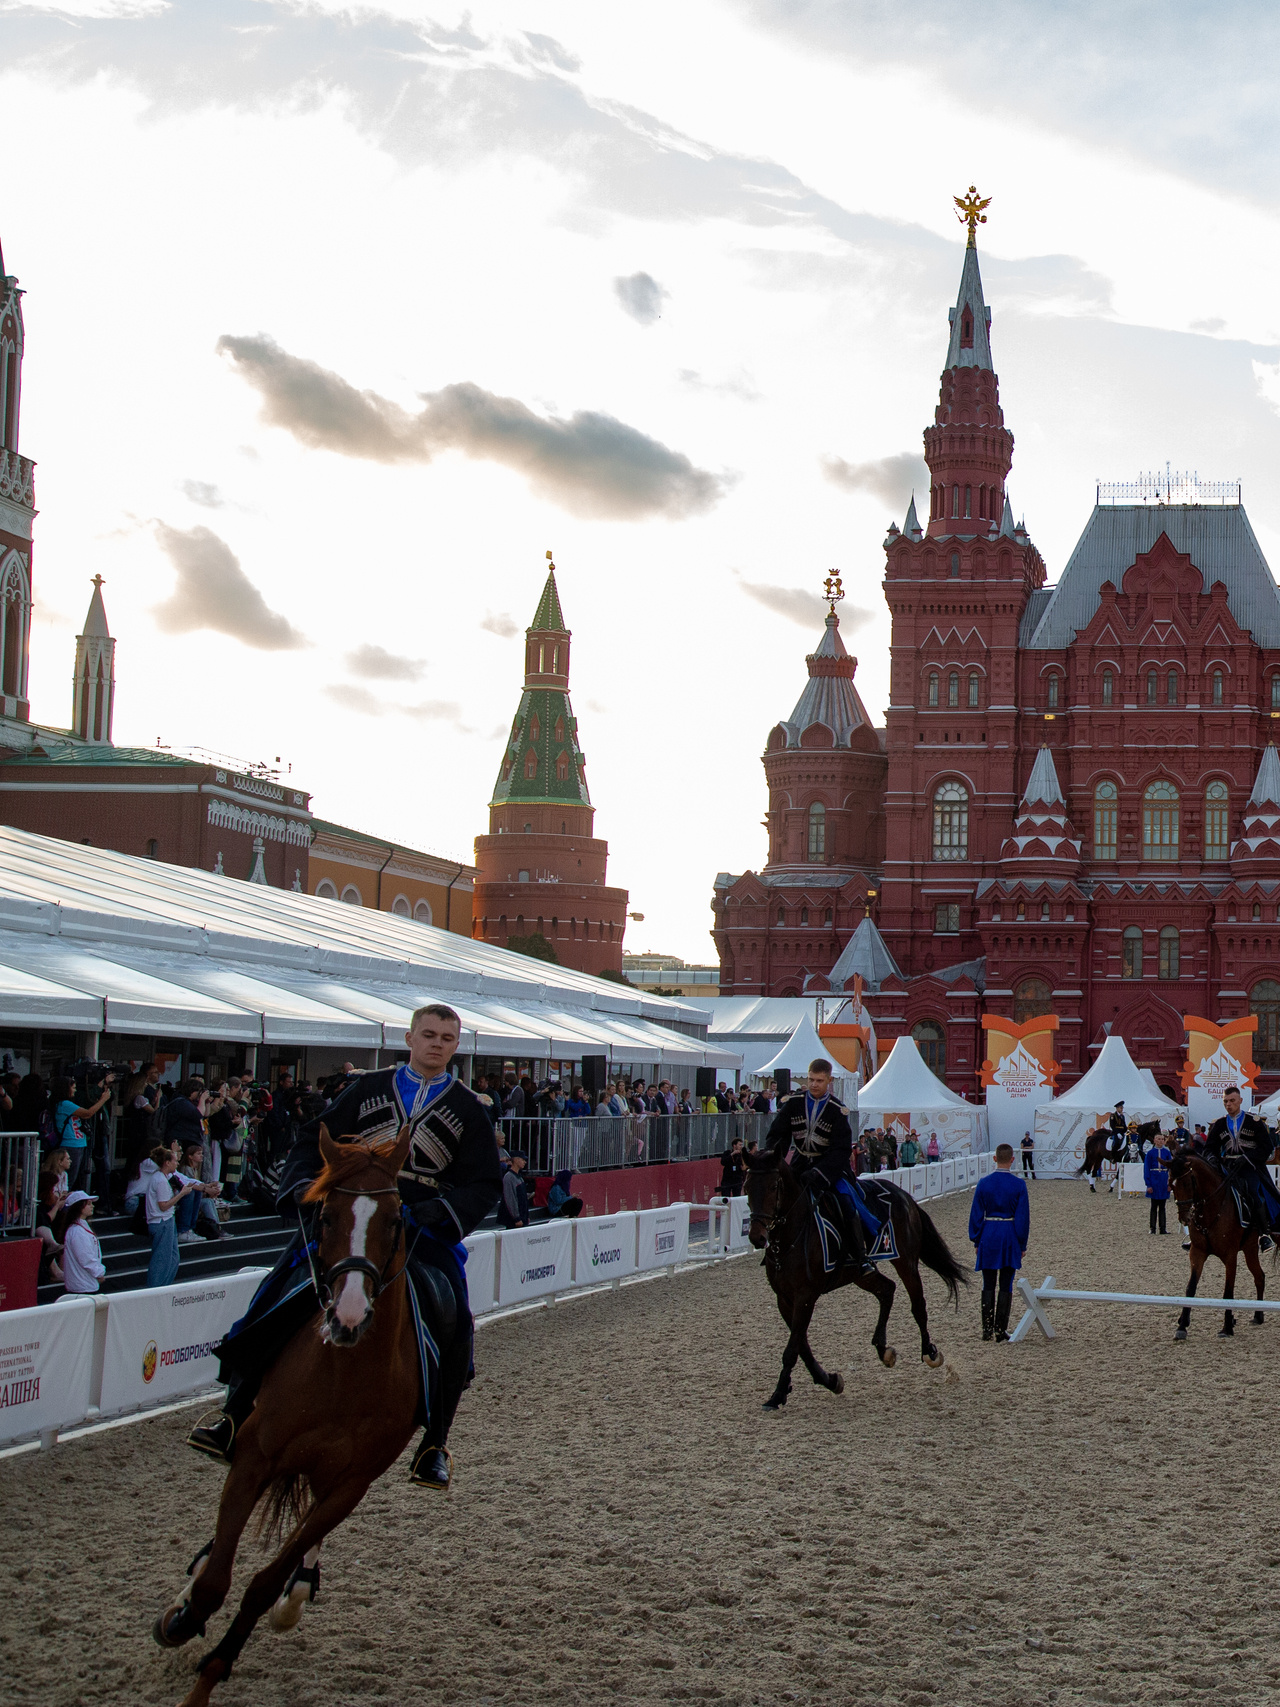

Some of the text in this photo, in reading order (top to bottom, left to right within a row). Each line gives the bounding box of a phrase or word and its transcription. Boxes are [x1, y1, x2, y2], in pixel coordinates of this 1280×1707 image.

[600, 1248, 620, 1264] ФОСАГРО
[526, 1264, 556, 1282] ТРАНСНЕФТЬ
[172, 1290, 226, 1307] Генеральный спонсор
[0, 1341, 40, 1356] PASSKAYA TOWER
[160, 1339, 222, 1367] РОСОБОРОНЭК
[0, 1355, 32, 1369] TERNATIONAL
[18, 1366, 35, 1377] TATTOO
[0, 1377, 41, 1408] АШНЯ
